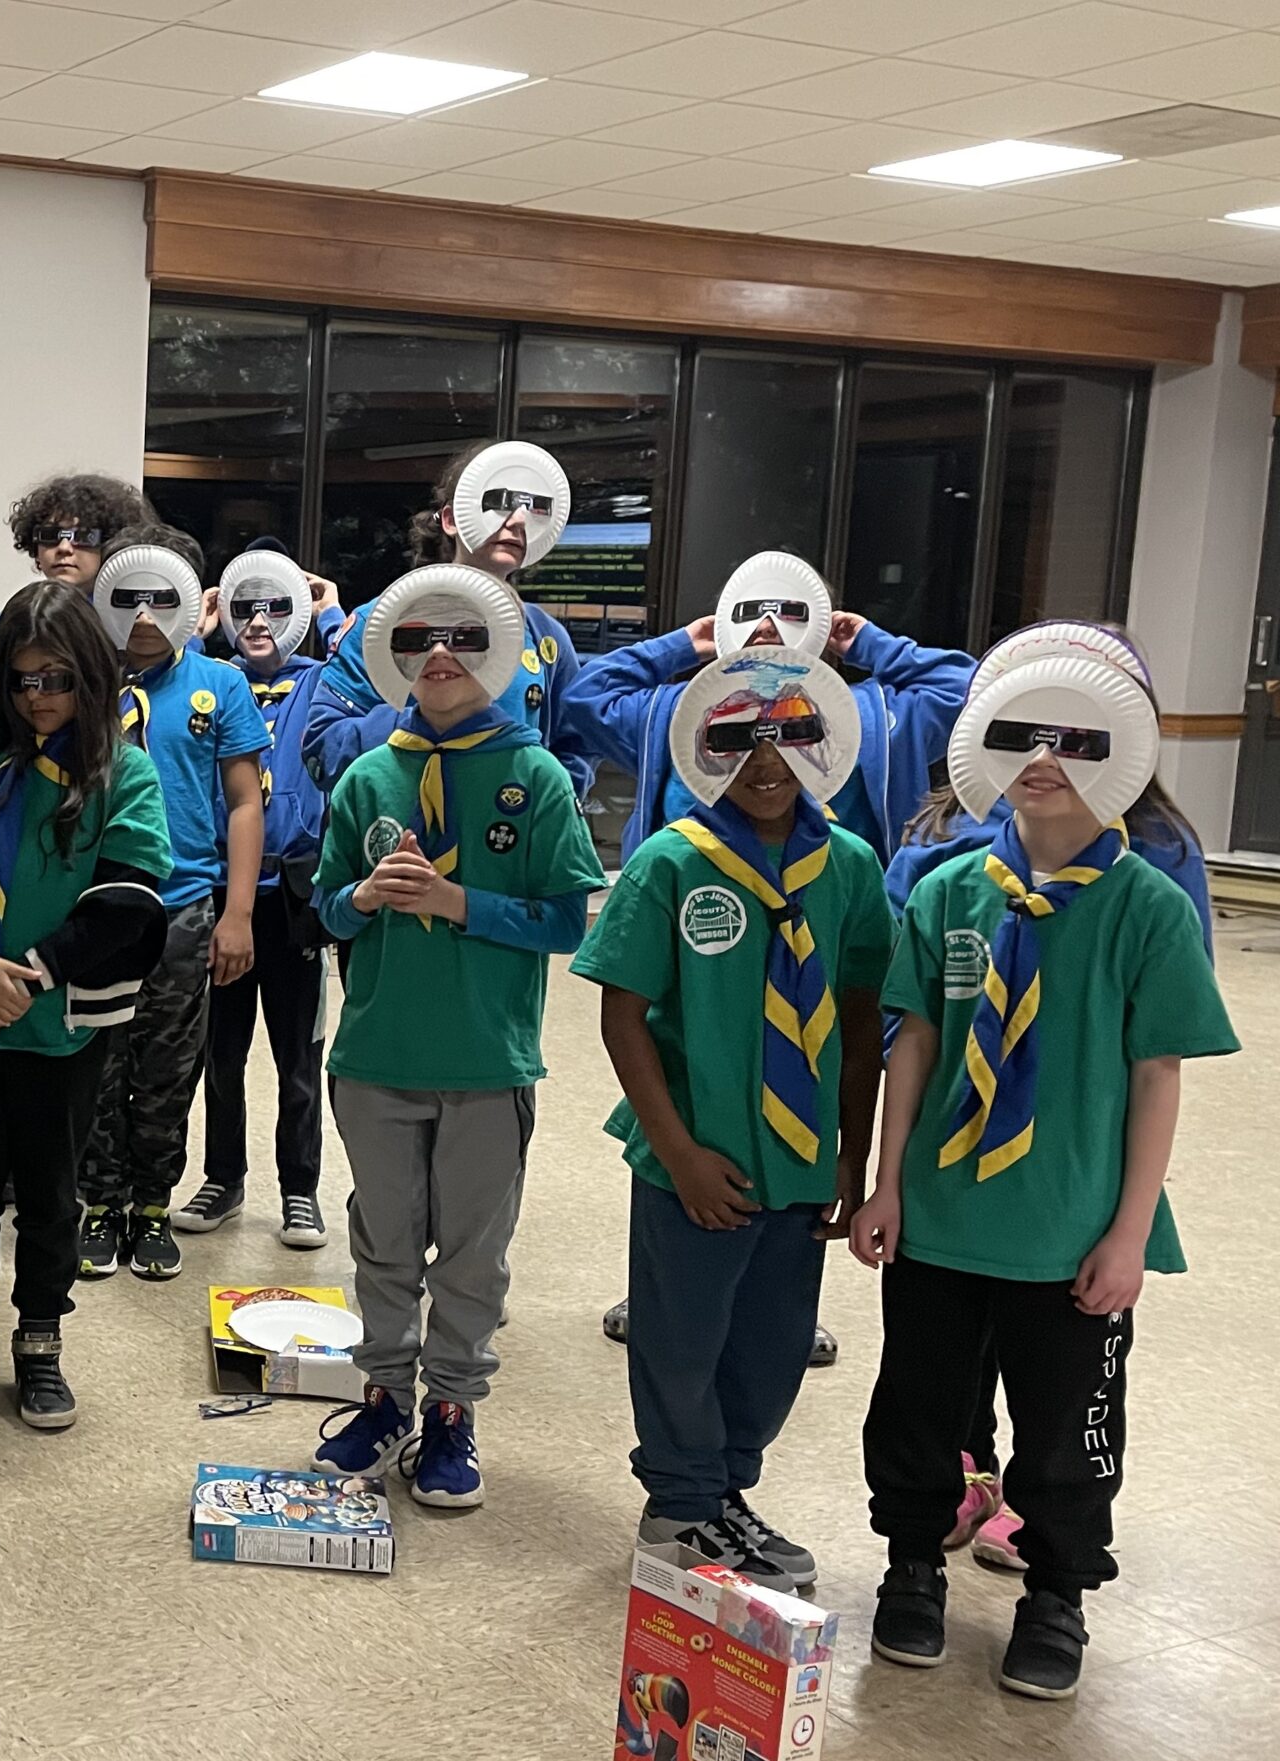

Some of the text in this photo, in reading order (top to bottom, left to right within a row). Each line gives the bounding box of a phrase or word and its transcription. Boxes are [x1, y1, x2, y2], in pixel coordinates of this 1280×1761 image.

[640, 1618, 685, 1646] TOGETHER!
[653, 1614, 675, 1630] LOOP
[711, 1654, 741, 1678] MONDE
[726, 1644, 769, 1674] ENSEMBLE
